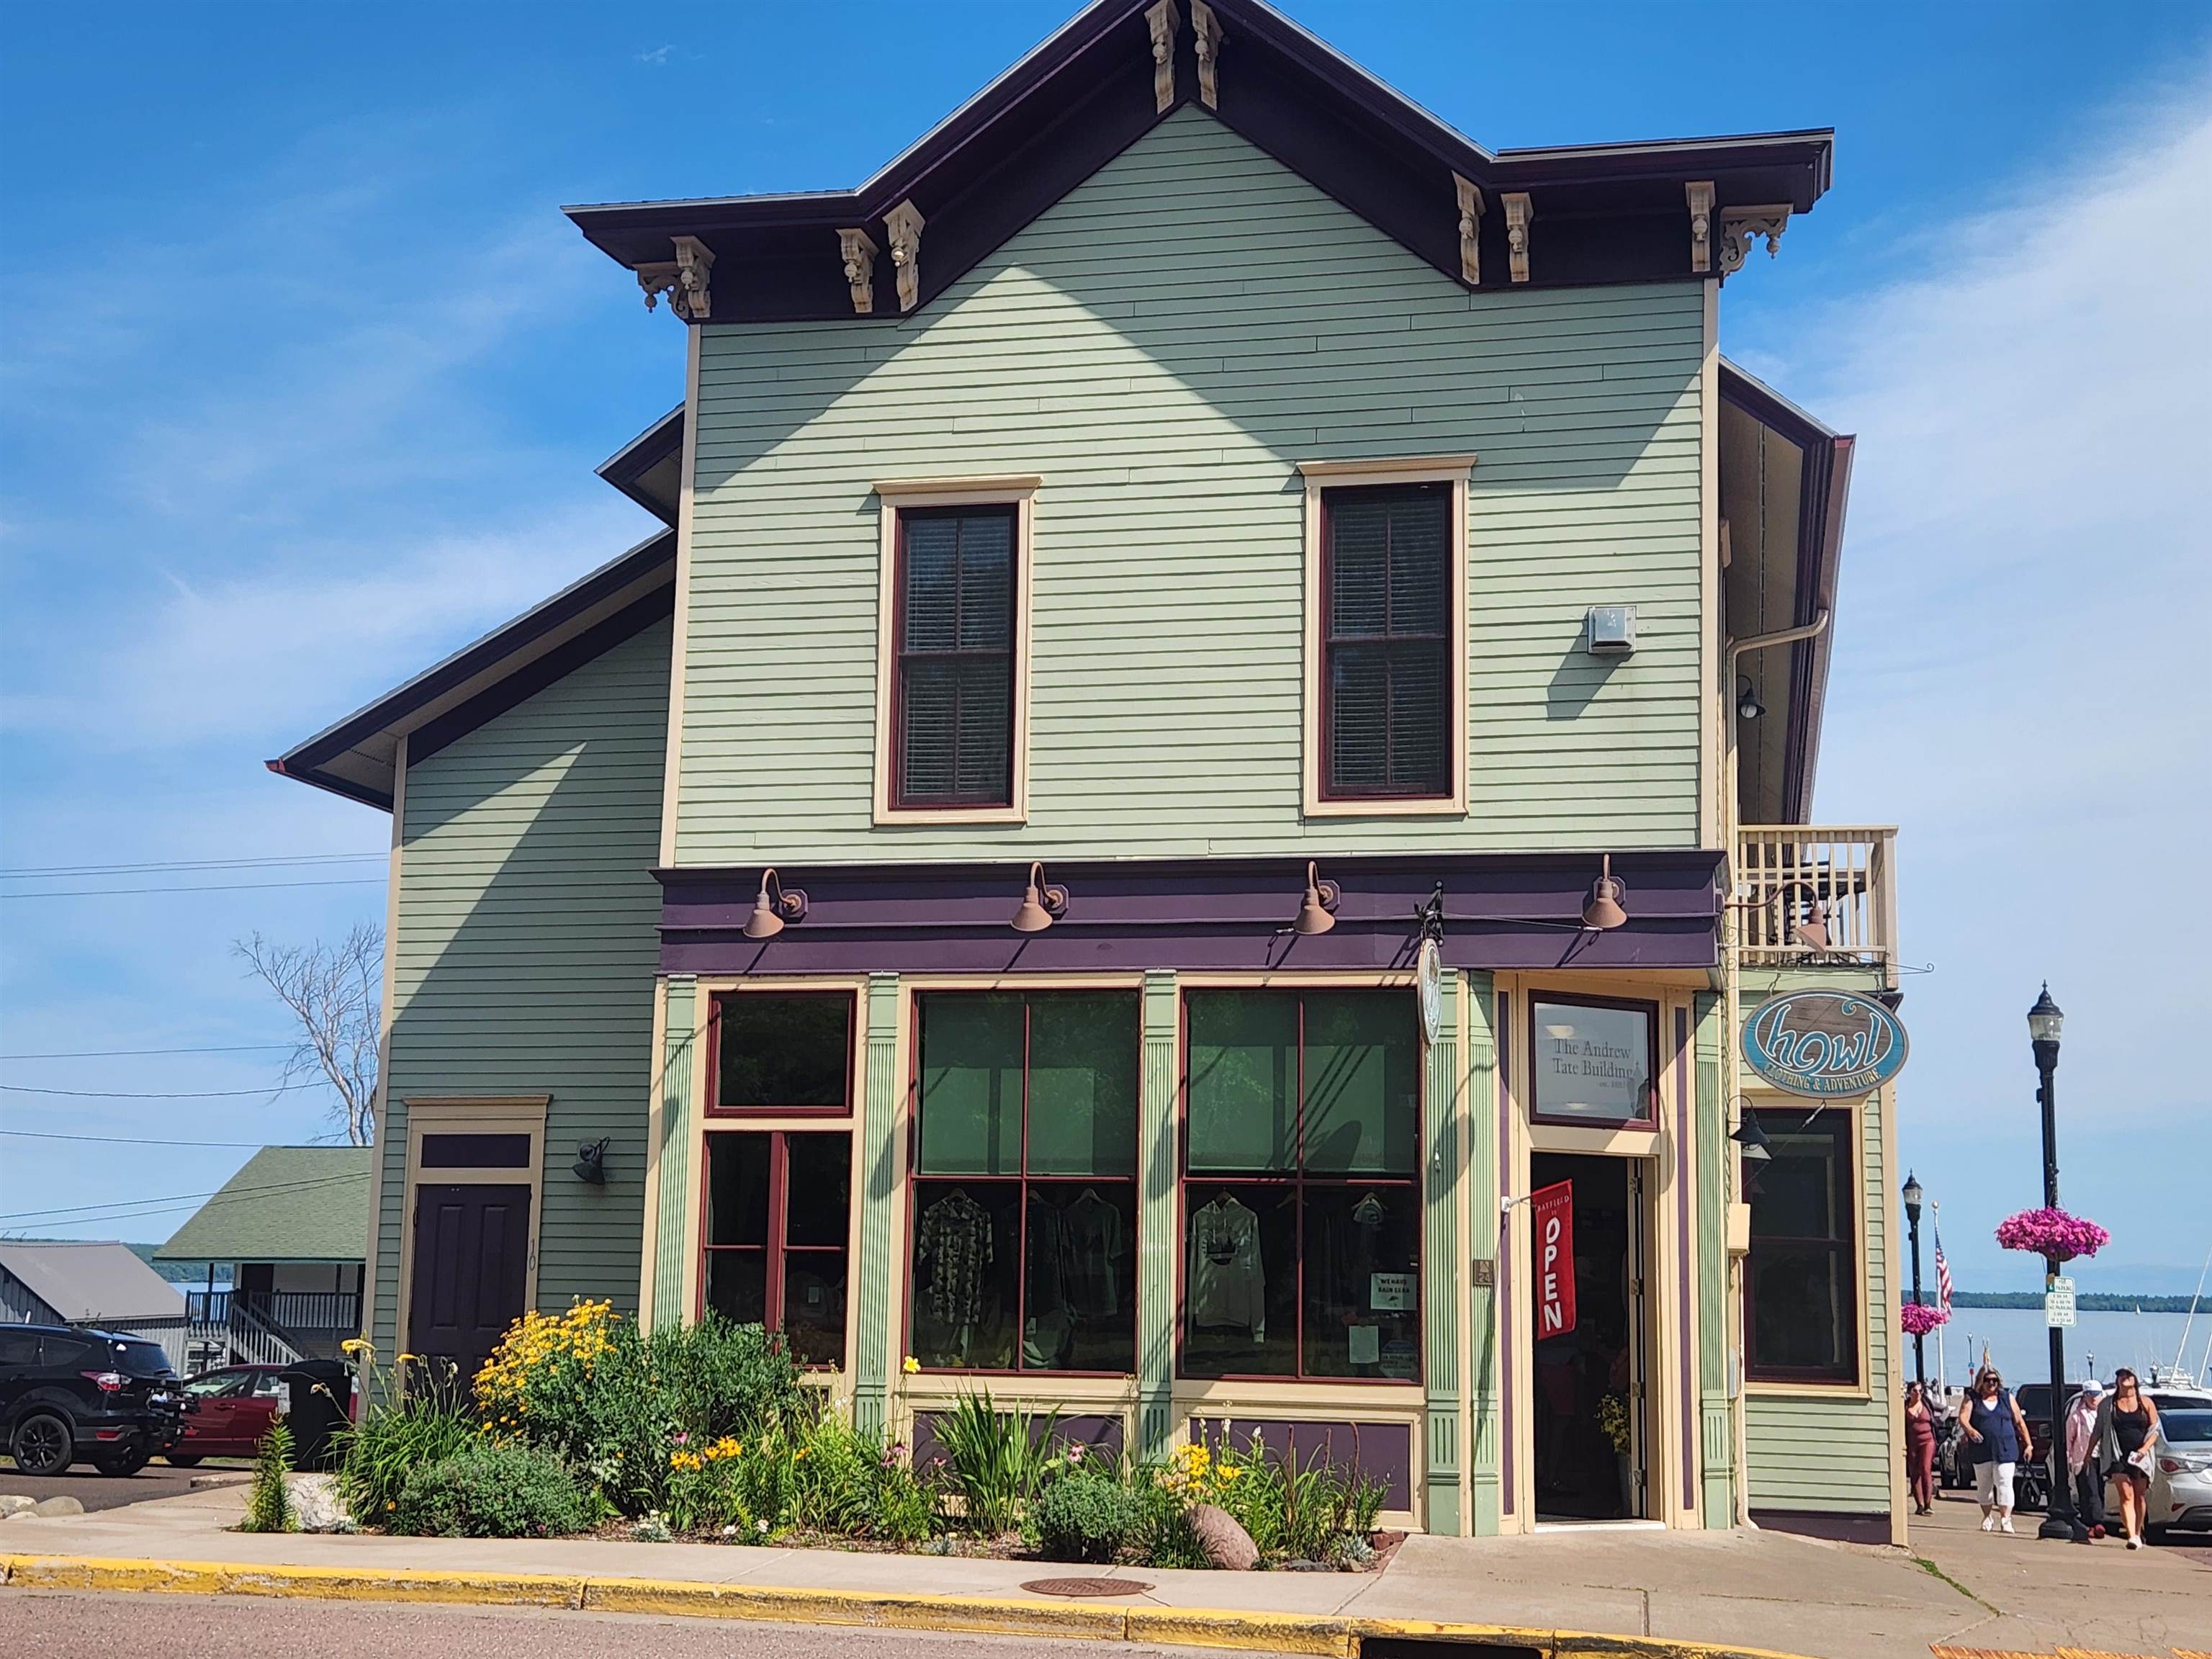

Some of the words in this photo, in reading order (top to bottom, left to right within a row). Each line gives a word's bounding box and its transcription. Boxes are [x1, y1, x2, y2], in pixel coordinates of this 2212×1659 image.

[1553, 1038, 1578, 1055] The
[1582, 1040, 1631, 1058] Andrew
[1766, 1003, 1881, 1074] howl
[1552, 1058, 1579, 1074] Tate
[1581, 1060, 1634, 1080] Building
[1763, 1062, 1810, 1090] CLOTHING
[1812, 1076, 1821, 1091] &
[1823, 1068, 1883, 1092] ADVENTURE
[1543, 1216, 1563, 1332] OPEN
